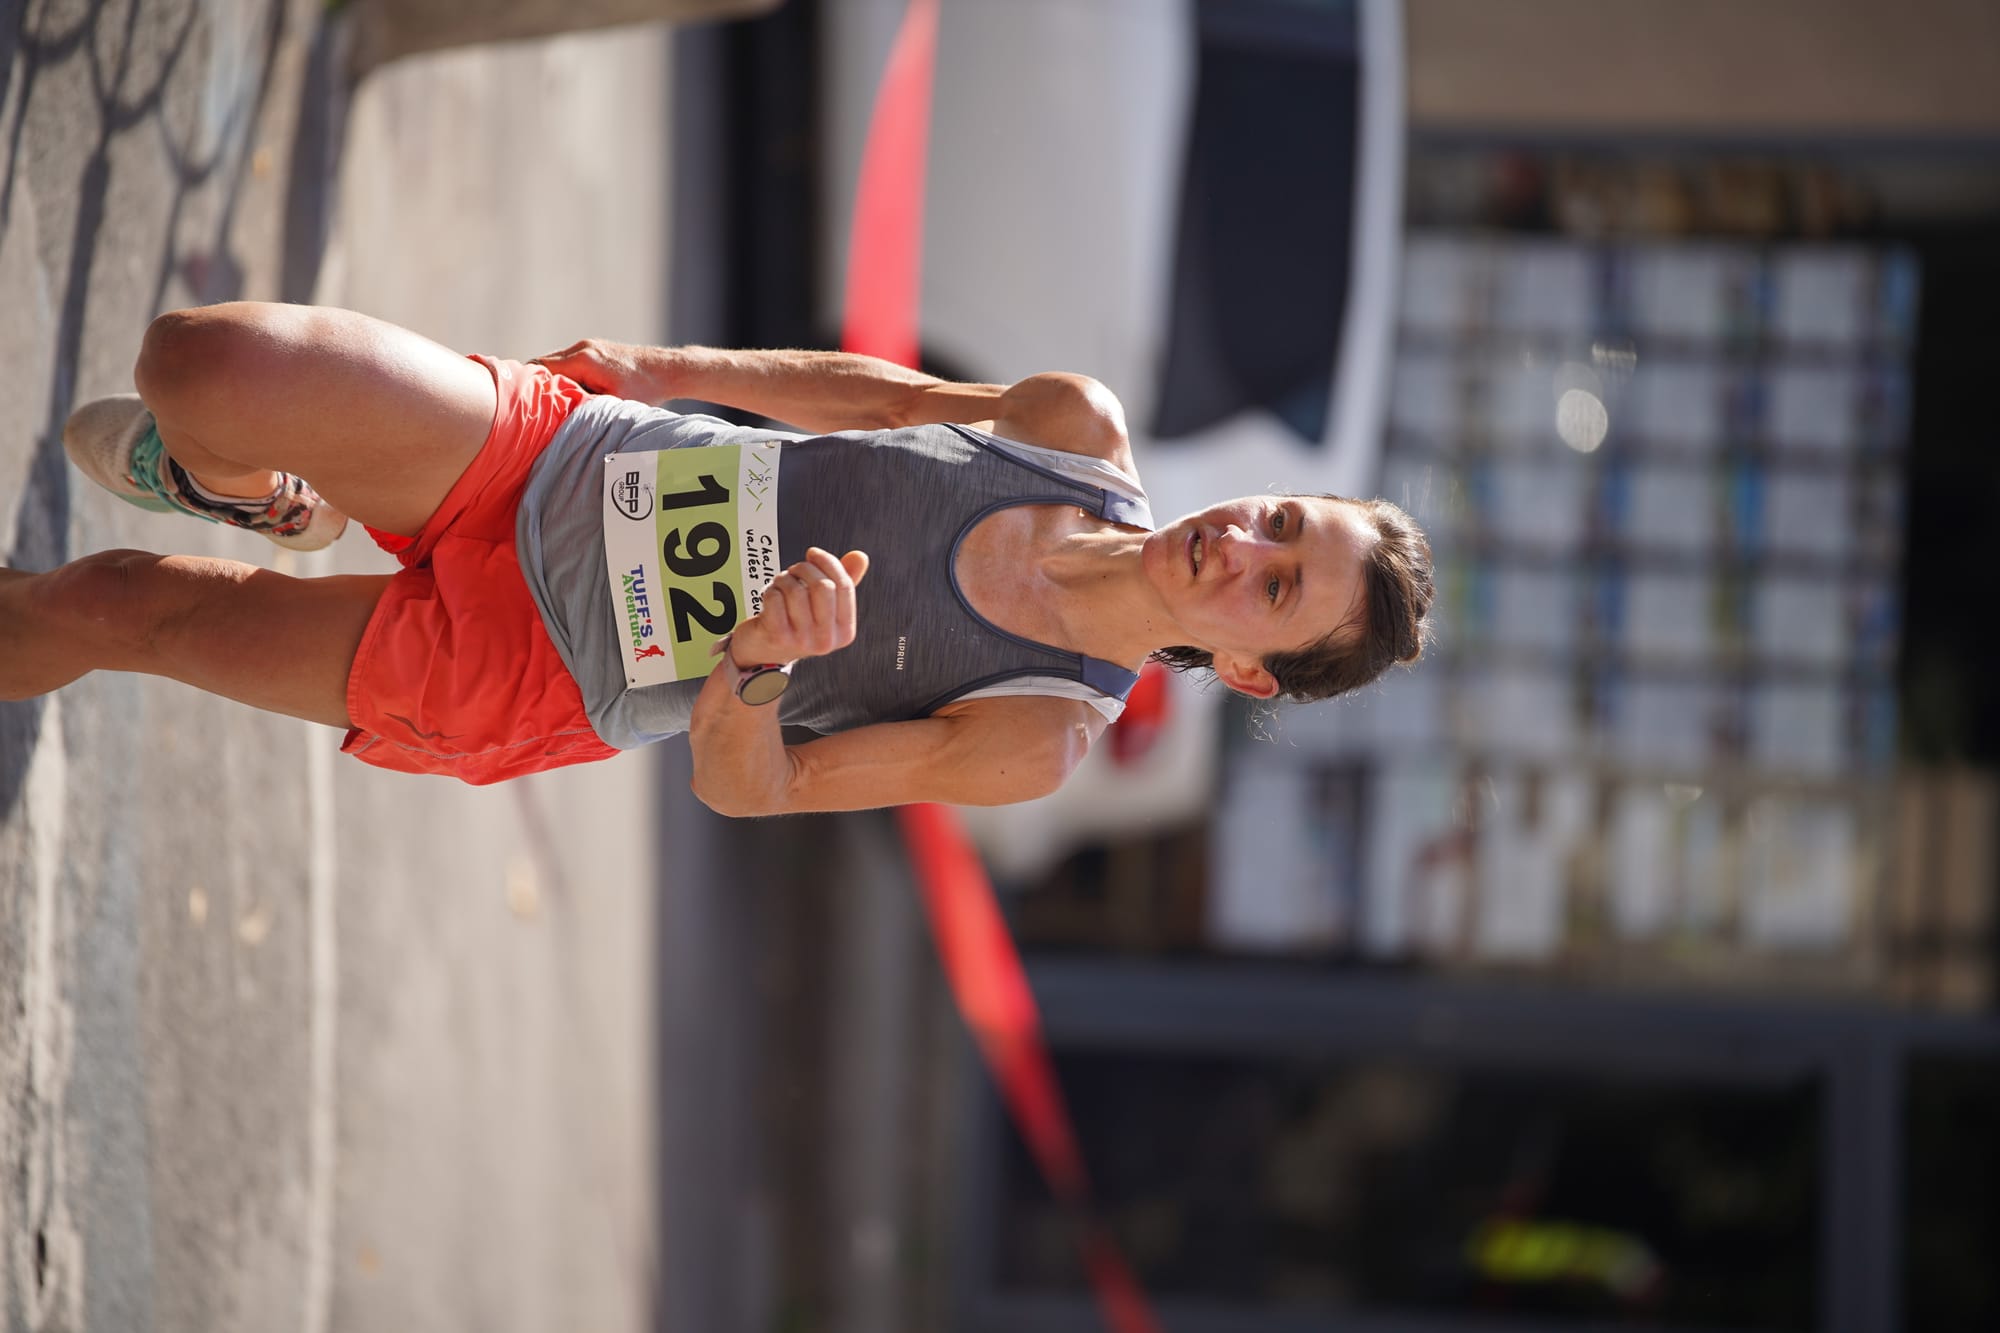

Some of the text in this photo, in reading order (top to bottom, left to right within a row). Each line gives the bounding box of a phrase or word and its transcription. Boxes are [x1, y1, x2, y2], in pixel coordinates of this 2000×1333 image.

[625, 471, 640, 513] BFP
[662, 474, 737, 643] 192
[746, 529, 760, 579] vallées
[760, 535, 775, 586] Challe
[621, 574, 642, 647] Aventure
[630, 564, 653, 638] TUFF'S
[895, 636, 906, 670] KIPRUN
